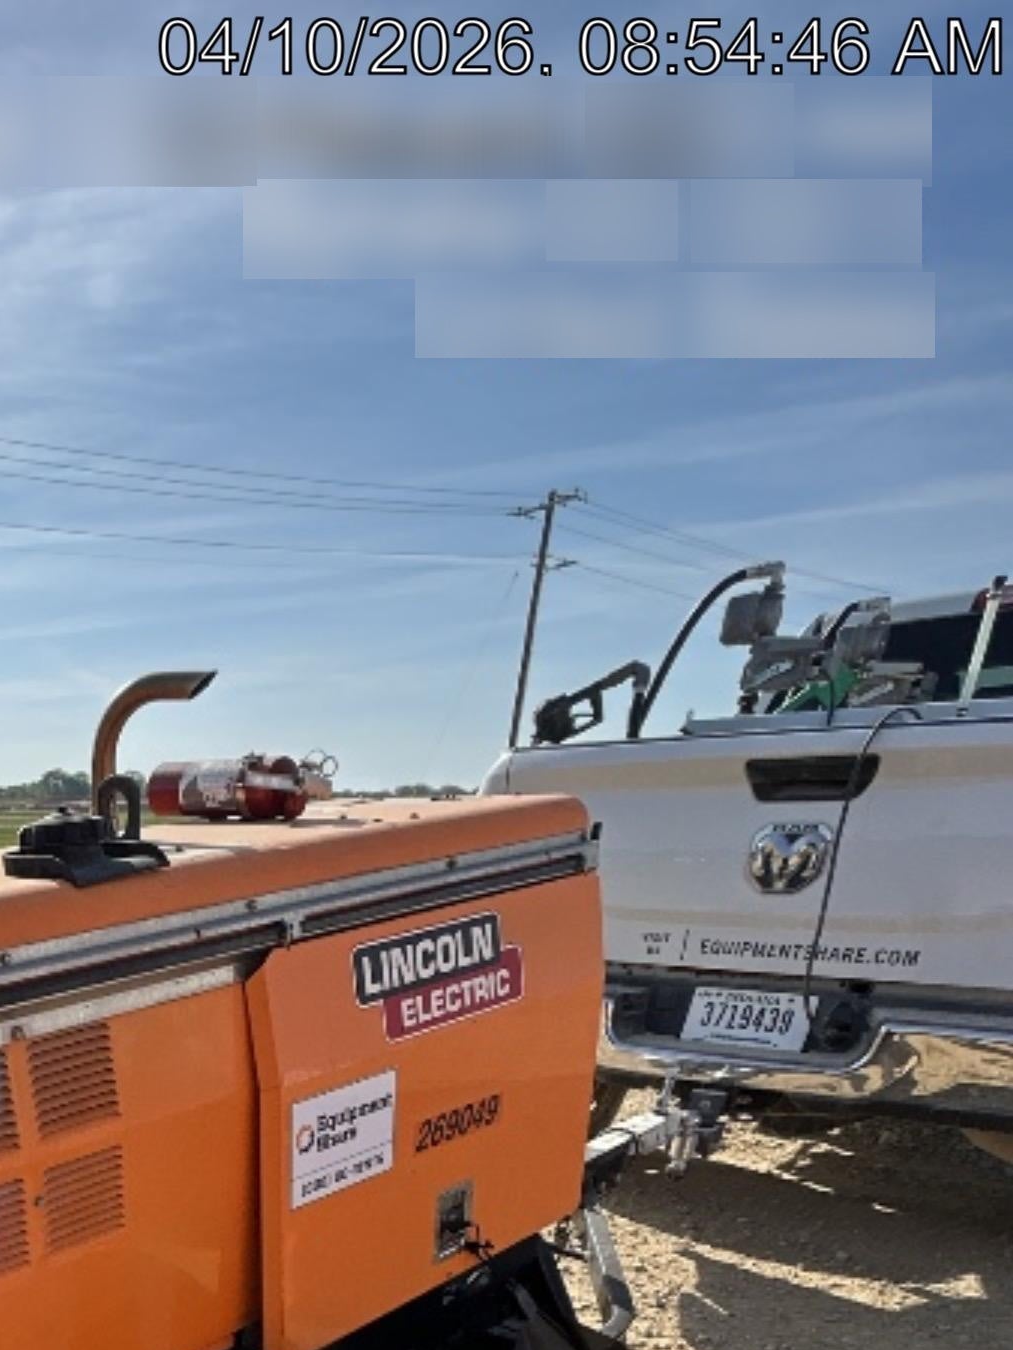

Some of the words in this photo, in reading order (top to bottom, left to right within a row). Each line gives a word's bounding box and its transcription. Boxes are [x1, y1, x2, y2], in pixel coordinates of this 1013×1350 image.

[361, 922, 495, 996] LINCOLN
[699, 938, 922, 967] EQUIPMENTSHARE.COM
[400, 968, 511, 1028] ELECTRIC
[414, 1093, 500, 1152] 269049
